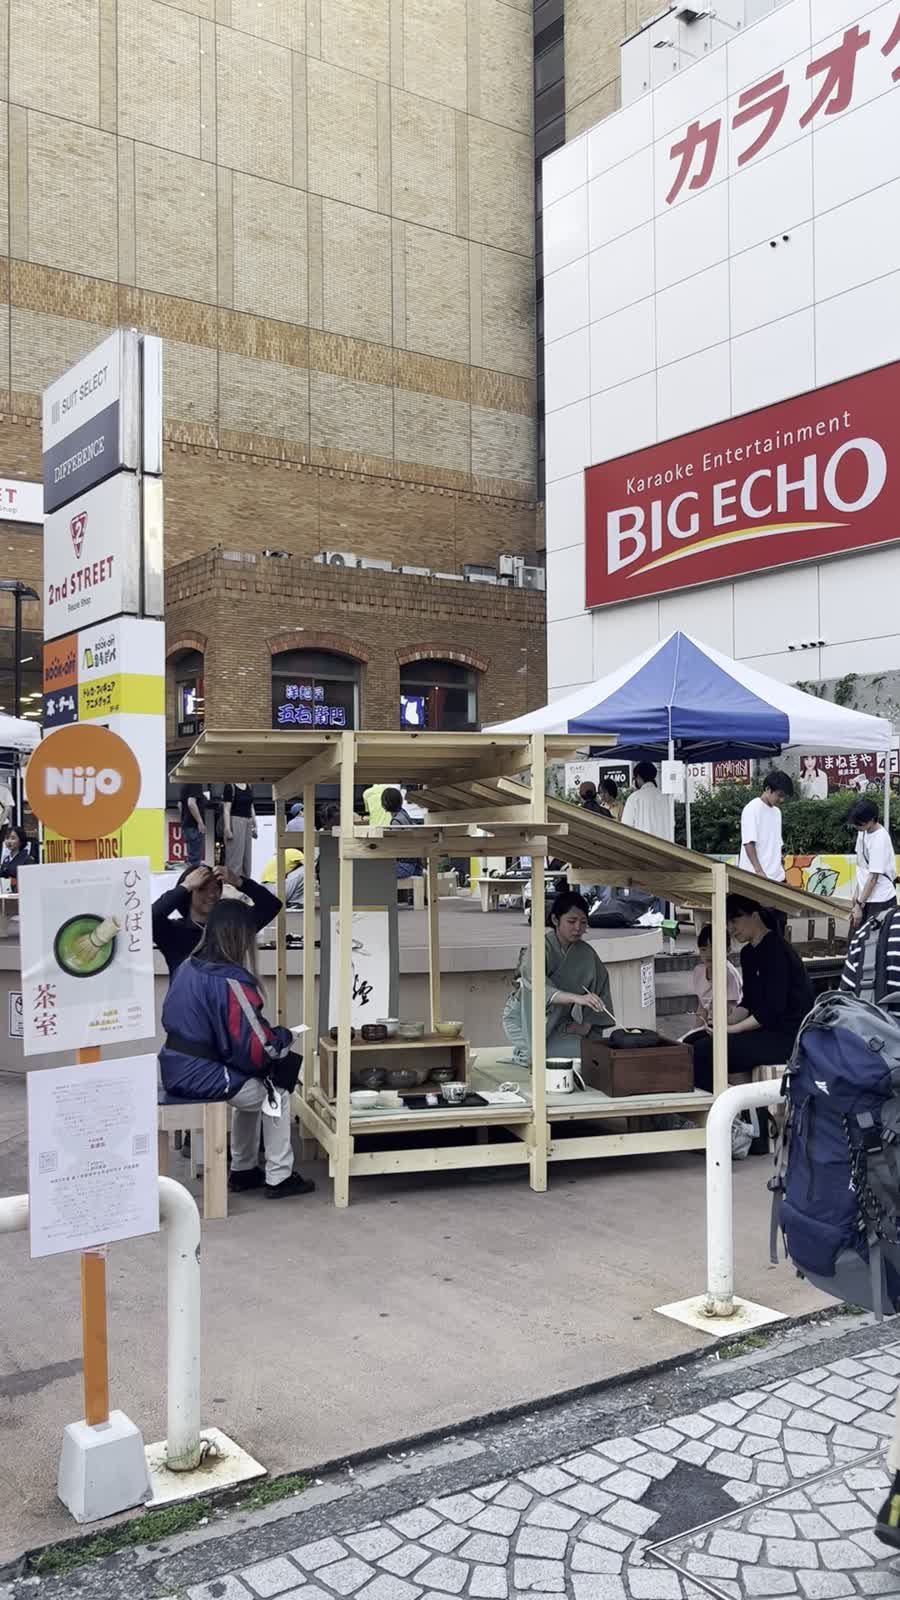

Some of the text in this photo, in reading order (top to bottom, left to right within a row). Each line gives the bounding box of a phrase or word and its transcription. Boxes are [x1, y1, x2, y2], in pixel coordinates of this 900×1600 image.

[665, 12, 900, 205] カラオ
[62, 366, 108, 414] SUIT SELECT
[54, 435, 105, 483] DIFFERENCE
[626, 410, 852, 496] Karaoke Entertainment
[606, 437, 887, 576] BIG ECHO
[48, 555, 115, 606] 2nd STREET
[45, 766, 122, 806] Nijo
[122, 869, 144, 953] ひろばと
[32, 983, 58, 1037] 茶室
